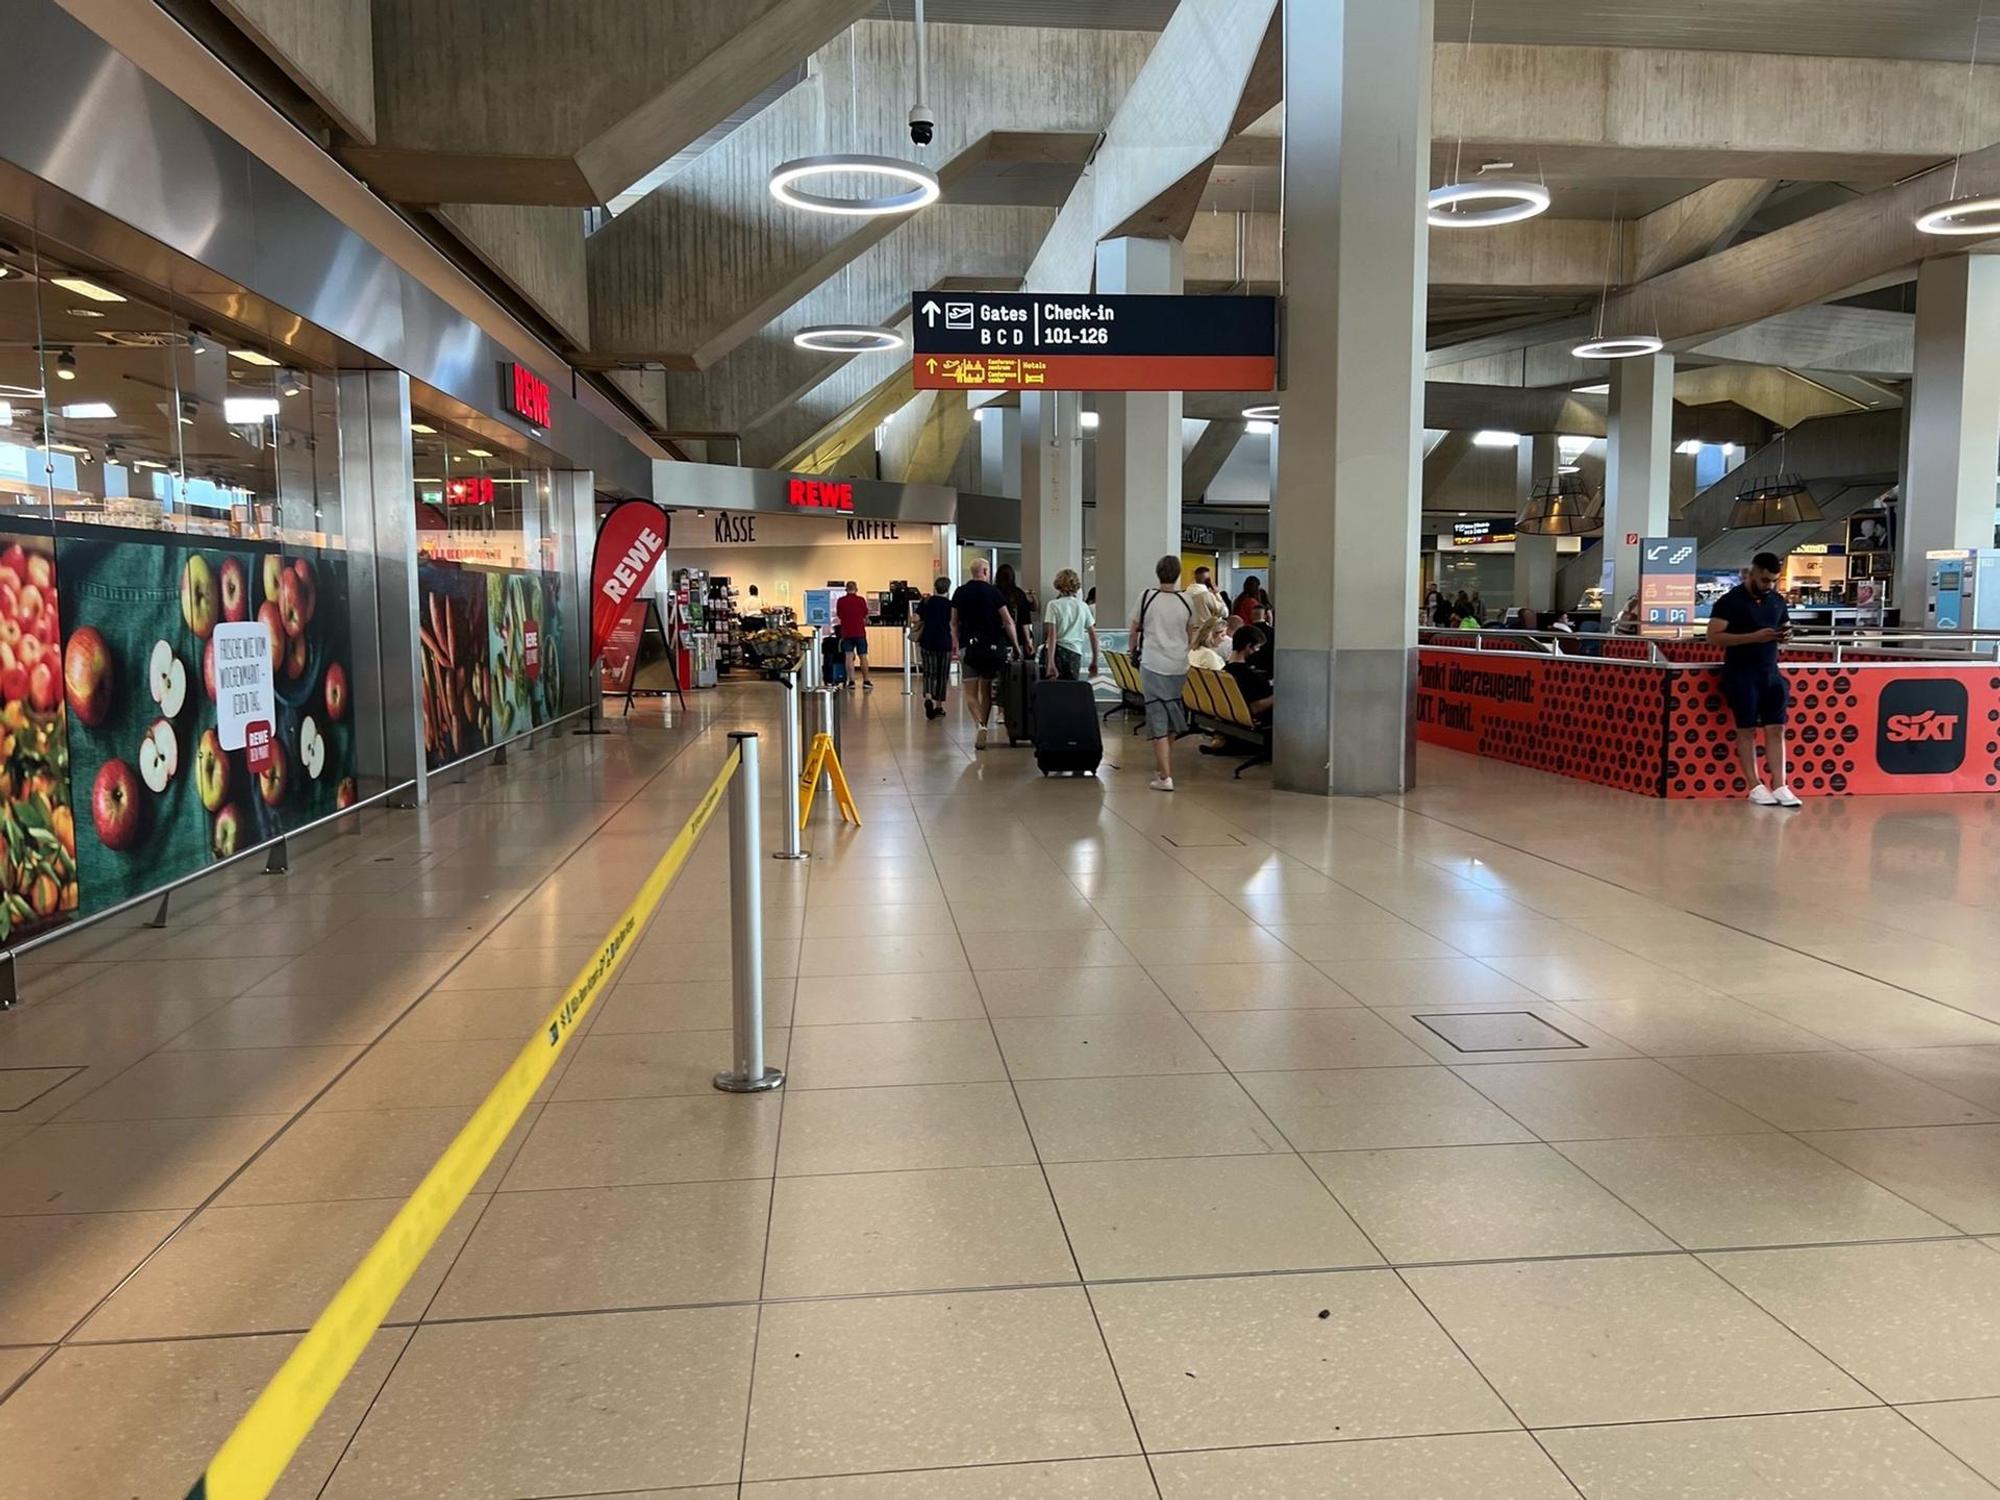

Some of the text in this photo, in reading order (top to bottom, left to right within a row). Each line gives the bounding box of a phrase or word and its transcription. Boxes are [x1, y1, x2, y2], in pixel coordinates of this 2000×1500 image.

[980, 304, 1028, 321] Gates
[1044, 303, 1114, 320] Check-in
[981, 328, 1023, 345] B C D
[1044, 327, 1108, 344] 101-126
[514, 361, 551, 429] REWE
[789, 479, 854, 510] REWE
[715, 515, 757, 543] KASSE
[847, 519, 899, 540] KAFFEE
[602, 527, 663, 605] REWE
[1448, 661, 1535, 704] überzeugend:
[1438, 696, 1474, 732] Punkt.
[1886, 710, 1959, 743] SIXT
[249, 730, 269, 747] REWE
